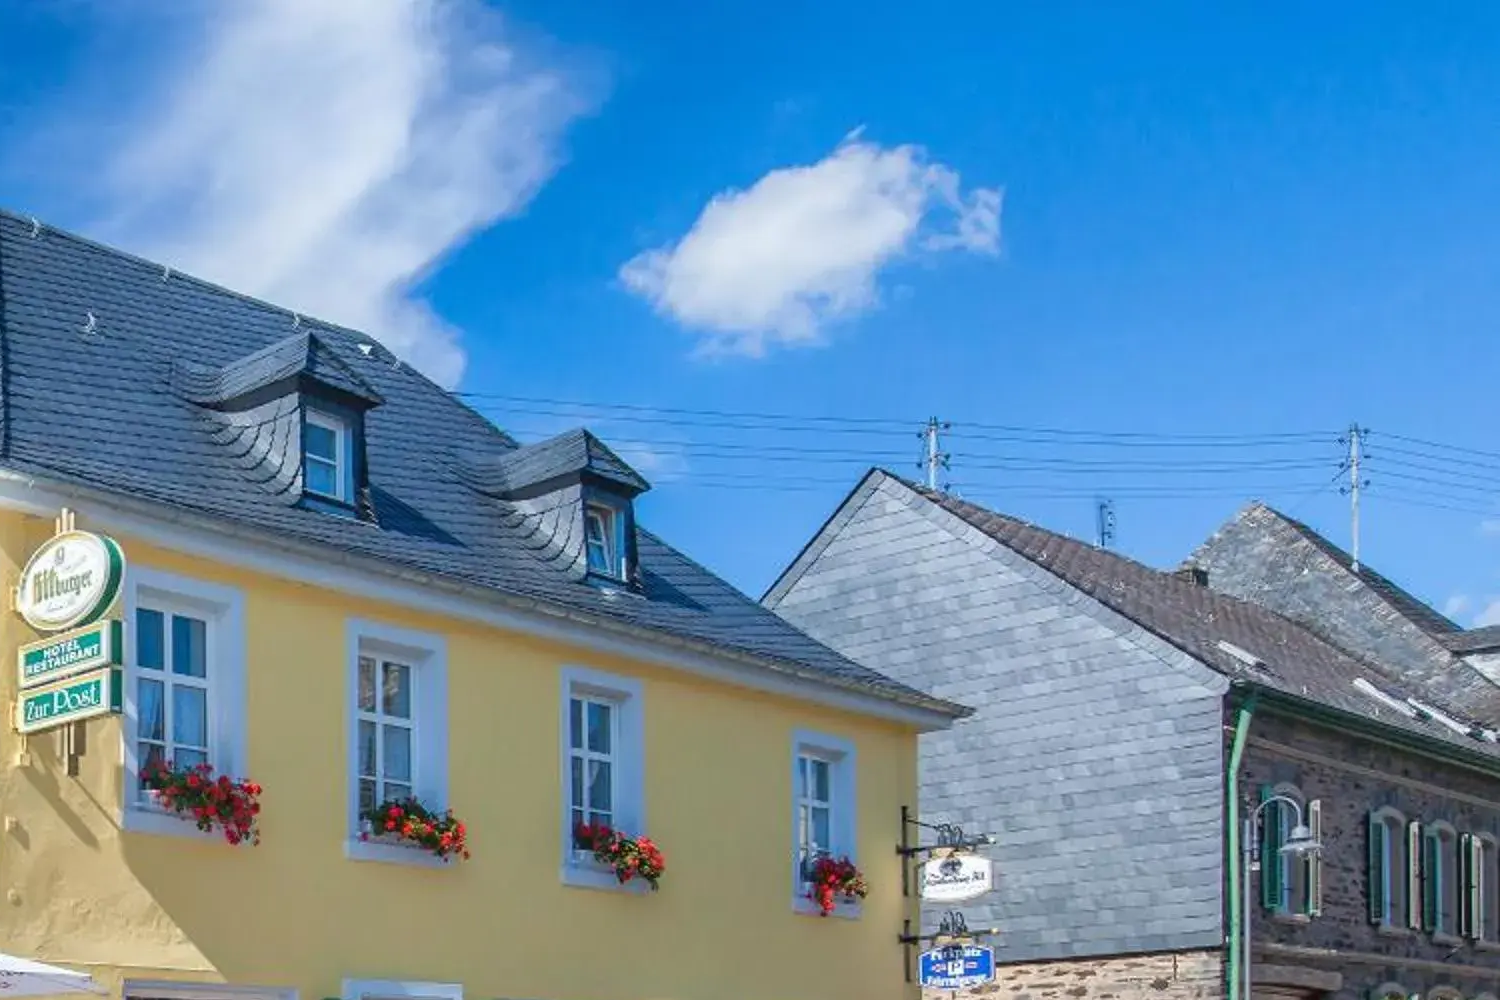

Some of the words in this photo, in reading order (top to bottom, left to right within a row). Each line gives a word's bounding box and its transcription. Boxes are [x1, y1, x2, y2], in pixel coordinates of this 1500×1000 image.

[25, 643, 100, 677] RESTAURANT
[43, 640, 81, 659] HOTEL
[26, 700, 50, 721] Zur
[53, 684, 97, 714] Post
